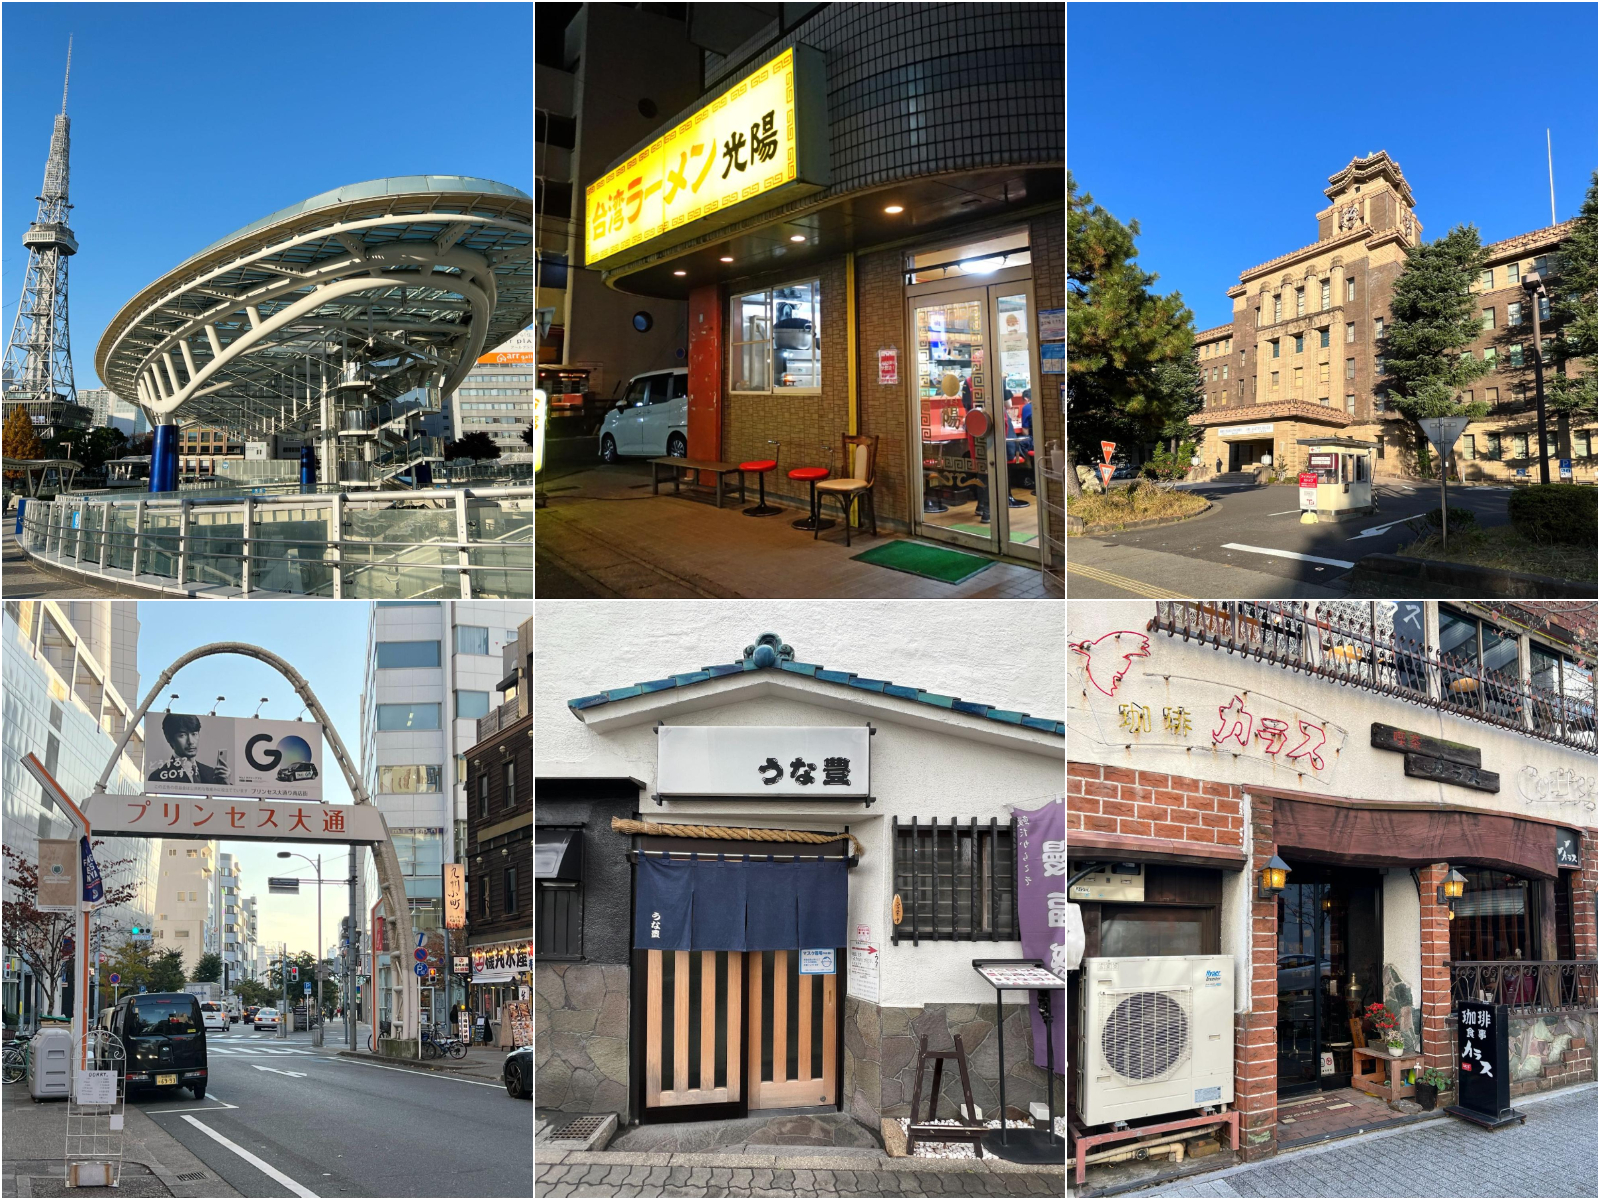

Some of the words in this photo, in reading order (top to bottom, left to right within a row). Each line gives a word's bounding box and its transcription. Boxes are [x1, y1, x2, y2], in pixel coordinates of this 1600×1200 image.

[592, 138, 717, 240] 台湾ラーメン
[721, 109, 779, 180] 光陽
[941, 406, 964, 430] 陽
[1402, 604, 1421, 630] ス
[1118, 701, 1193, 737] 珈琲
[1212, 694, 1326, 770] カラス
[1393, 730, 1422, 751] 喫茶
[245, 733, 312, 772] GO
[758, 756, 851, 786] うな豊
[127, 800, 346, 834] プリンセス大通
[447, 866, 461, 910] 九州小町
[485, 943, 528, 970] 磯丸水産
[1461, 1008, 1492, 1028] 珈琲
[1466, 1027, 1487, 1041] 食事
[1461, 1039, 1494, 1078] カラス
